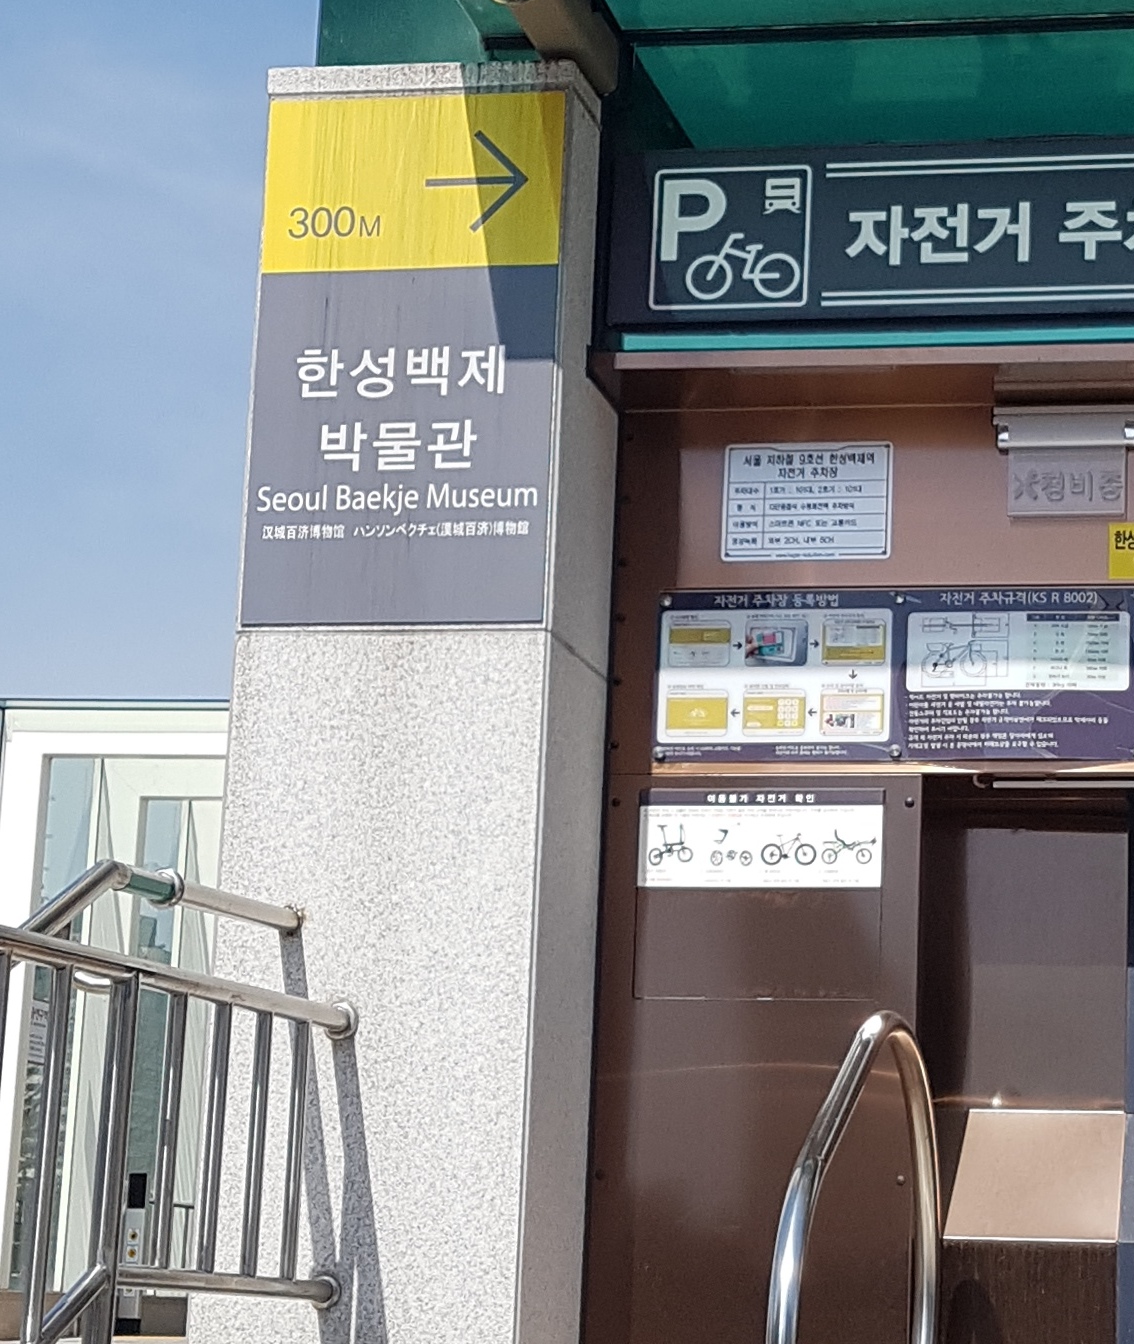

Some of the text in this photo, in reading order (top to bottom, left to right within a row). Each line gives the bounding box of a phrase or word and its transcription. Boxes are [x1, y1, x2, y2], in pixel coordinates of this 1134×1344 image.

[288, 206, 381, 239] 300M
[660, 178, 727, 262] P
[845, 203, 1032, 265] 자전거
[296, 345, 506, 398] 한성백제
[320, 419, 478, 473] 박물관
[777, 466, 838, 479] 자전거 주차장
[257, 483, 538, 516] Seoul Baekje Museum
[262, 524, 345, 539] 汉城百济博物馆
[714, 594, 749, 607] 자전거
[792, 594, 839, 607] 등록방법
[940, 593, 975, 605] 자전거
[1051, 592, 1060, 604] R
[1063, 591, 1098, 604] 8002)
[755, 793, 787, 804] 자전거
